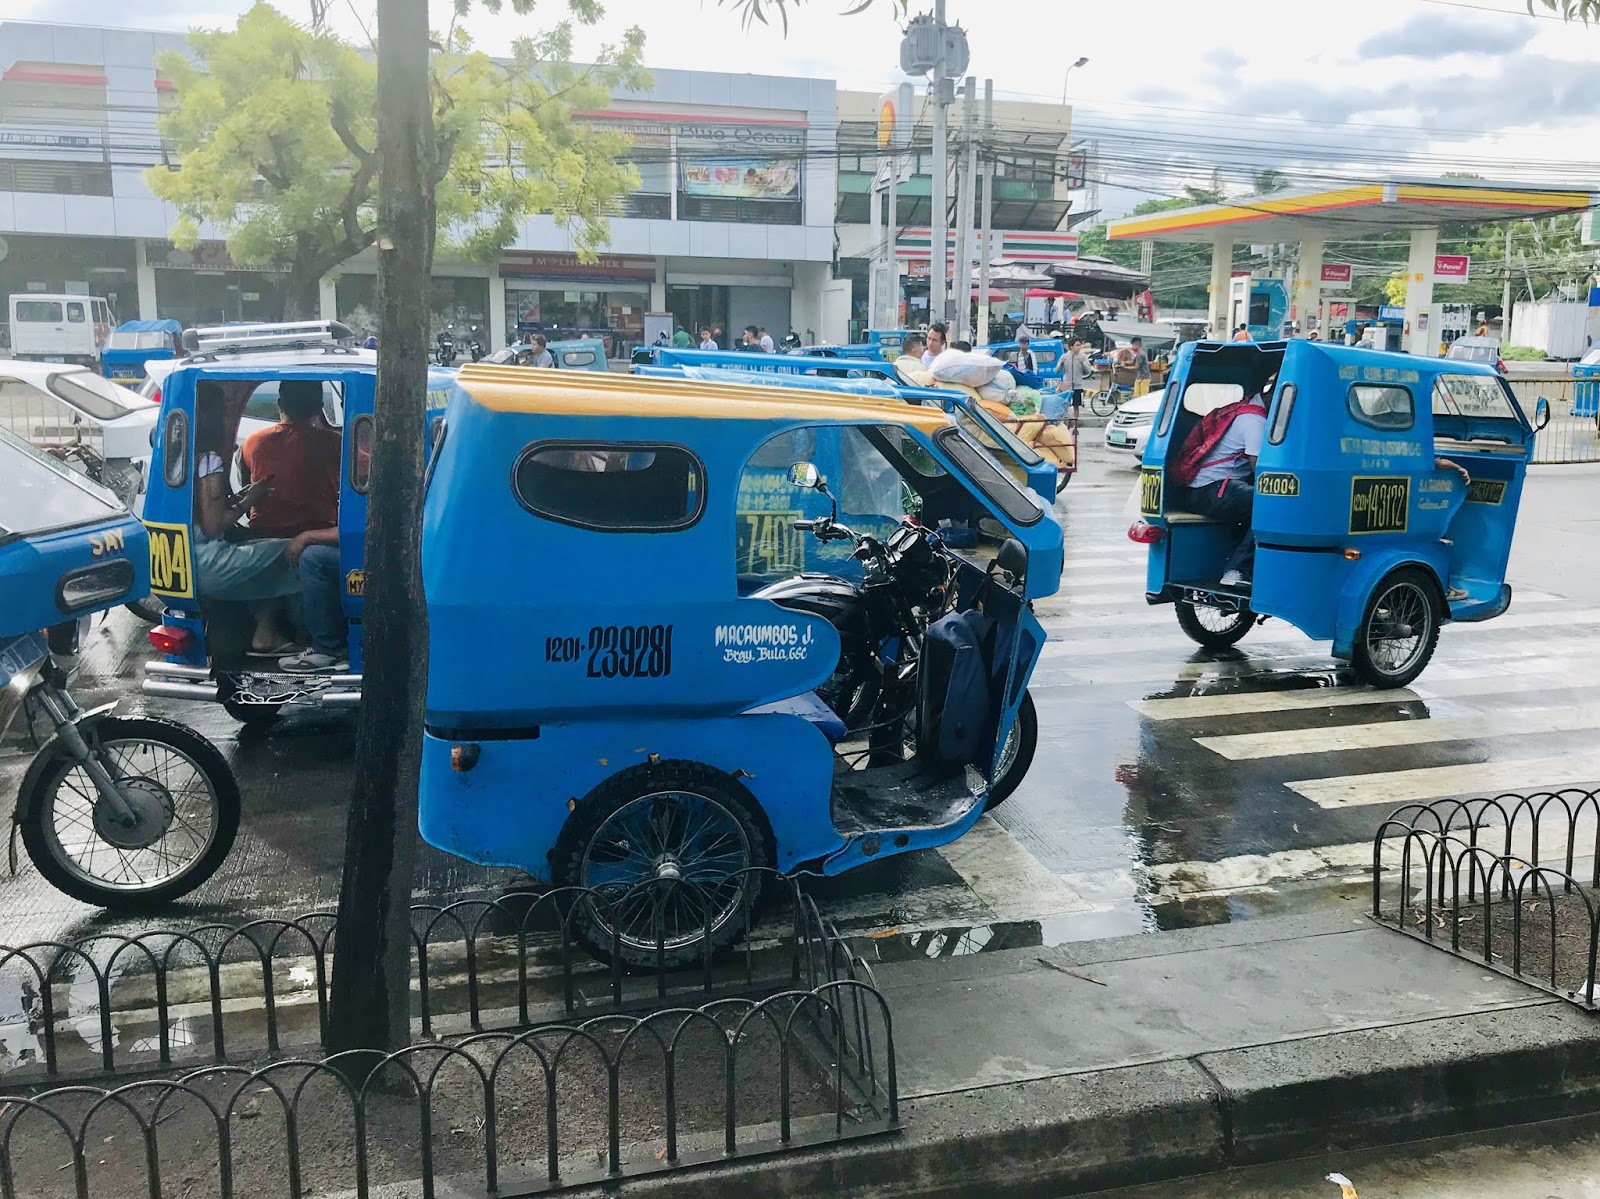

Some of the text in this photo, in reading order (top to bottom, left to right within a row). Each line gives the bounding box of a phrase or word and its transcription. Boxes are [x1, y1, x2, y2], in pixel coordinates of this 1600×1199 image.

[679, 126, 725, 141] Blue
[734, 127, 801, 144] Ocean
[1258, 477, 1296, 495] 121004
[89, 528, 125, 556] SAY
[715, 624, 815, 647] MACAUMBOS J.
